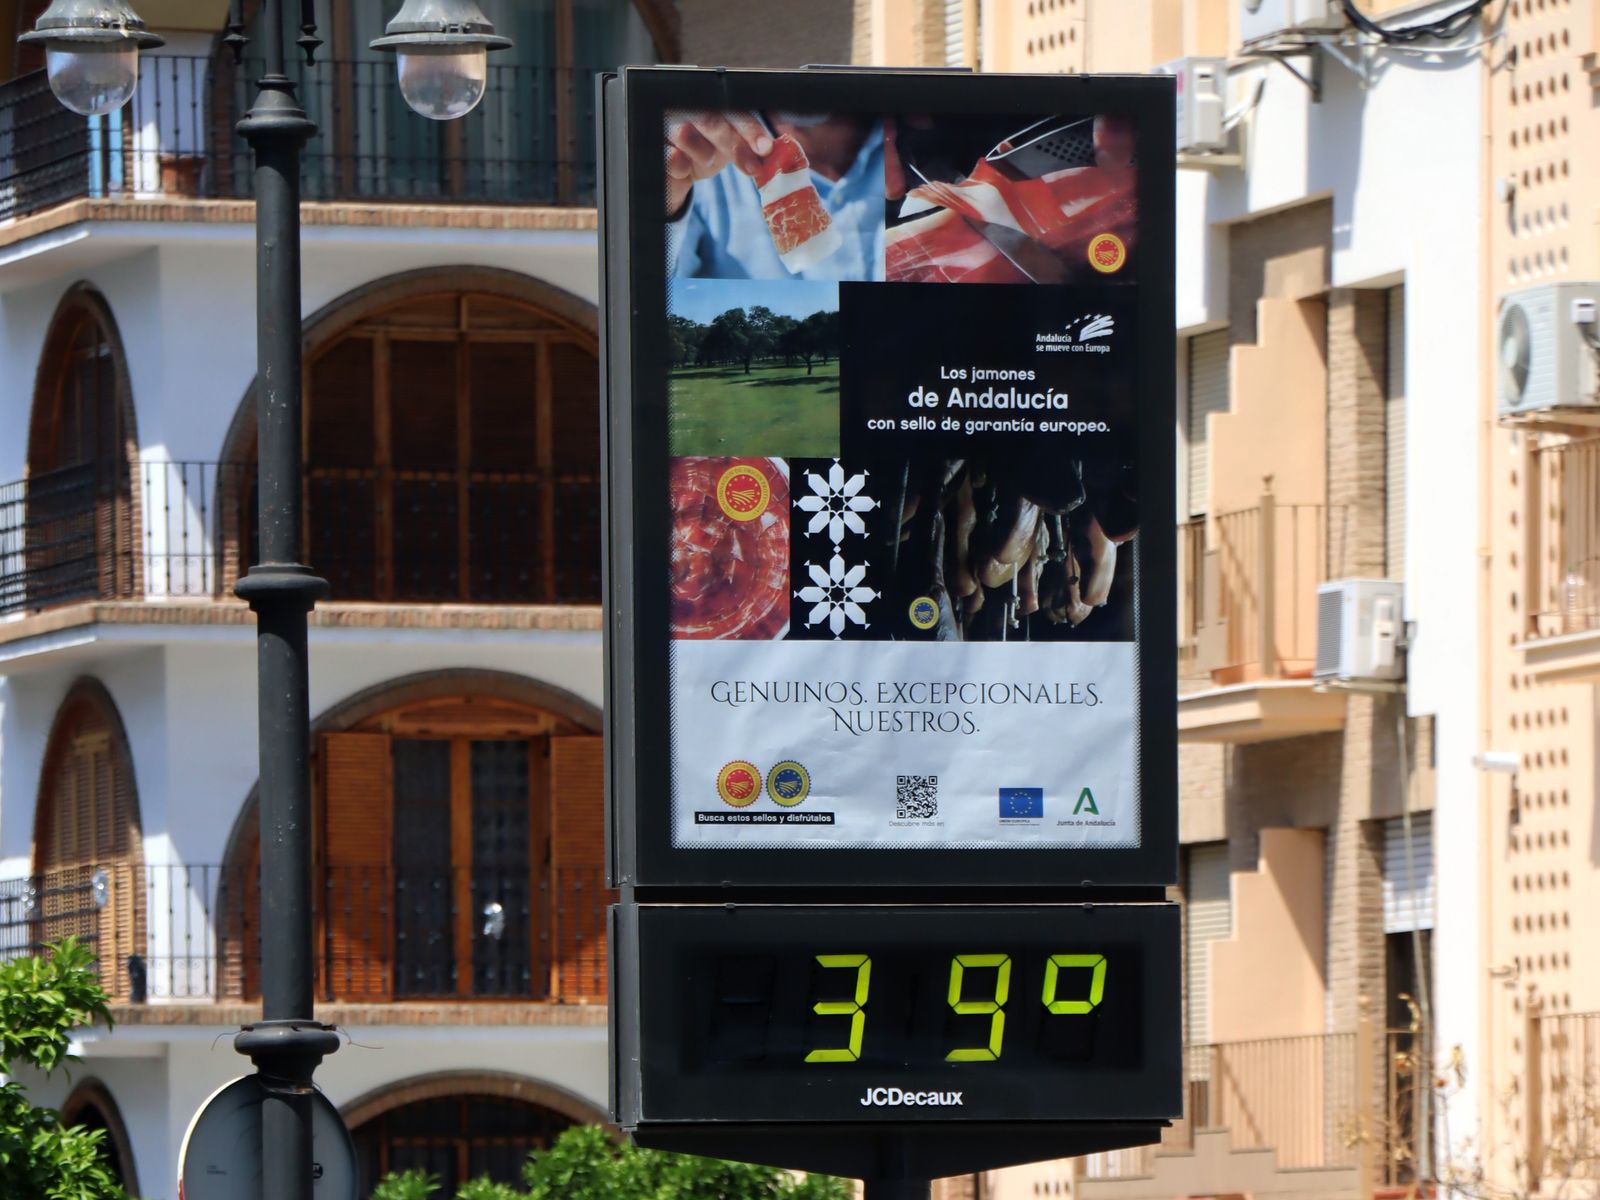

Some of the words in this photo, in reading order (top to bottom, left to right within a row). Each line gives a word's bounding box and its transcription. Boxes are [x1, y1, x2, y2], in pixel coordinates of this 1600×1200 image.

[1035, 344, 1044, 352] se
[1045, 344, 1070, 352] mueve
[1071, 344, 1084, 352] con
[1085, 343, 1111, 354] Europa
[940, 366, 967, 380] Los
[971, 366, 1036, 383] jamones
[908, 386, 939, 408] de
[947, 386, 1069, 409] Andalucía
[867, 418, 895, 430] con
[900, 416, 936, 431] sello
[941, 416, 961, 431] de
[965, 417, 1035, 435] garantía
[1039, 419, 1111, 436] europeo.
[711, 680, 868, 707] GENUINOS.
[877, 682, 1103, 707] EXCEPCIONALES.
[827, 707, 980, 737] NUESTROS.
[698, 813, 725, 822] Busca
[727, 814, 751, 822] estos
[752, 813, 777, 822] sellos
[779, 815, 785, 824] y
[786, 813, 832, 822] disfrútalos
[860, 1087, 964, 1106] JCDecaux
